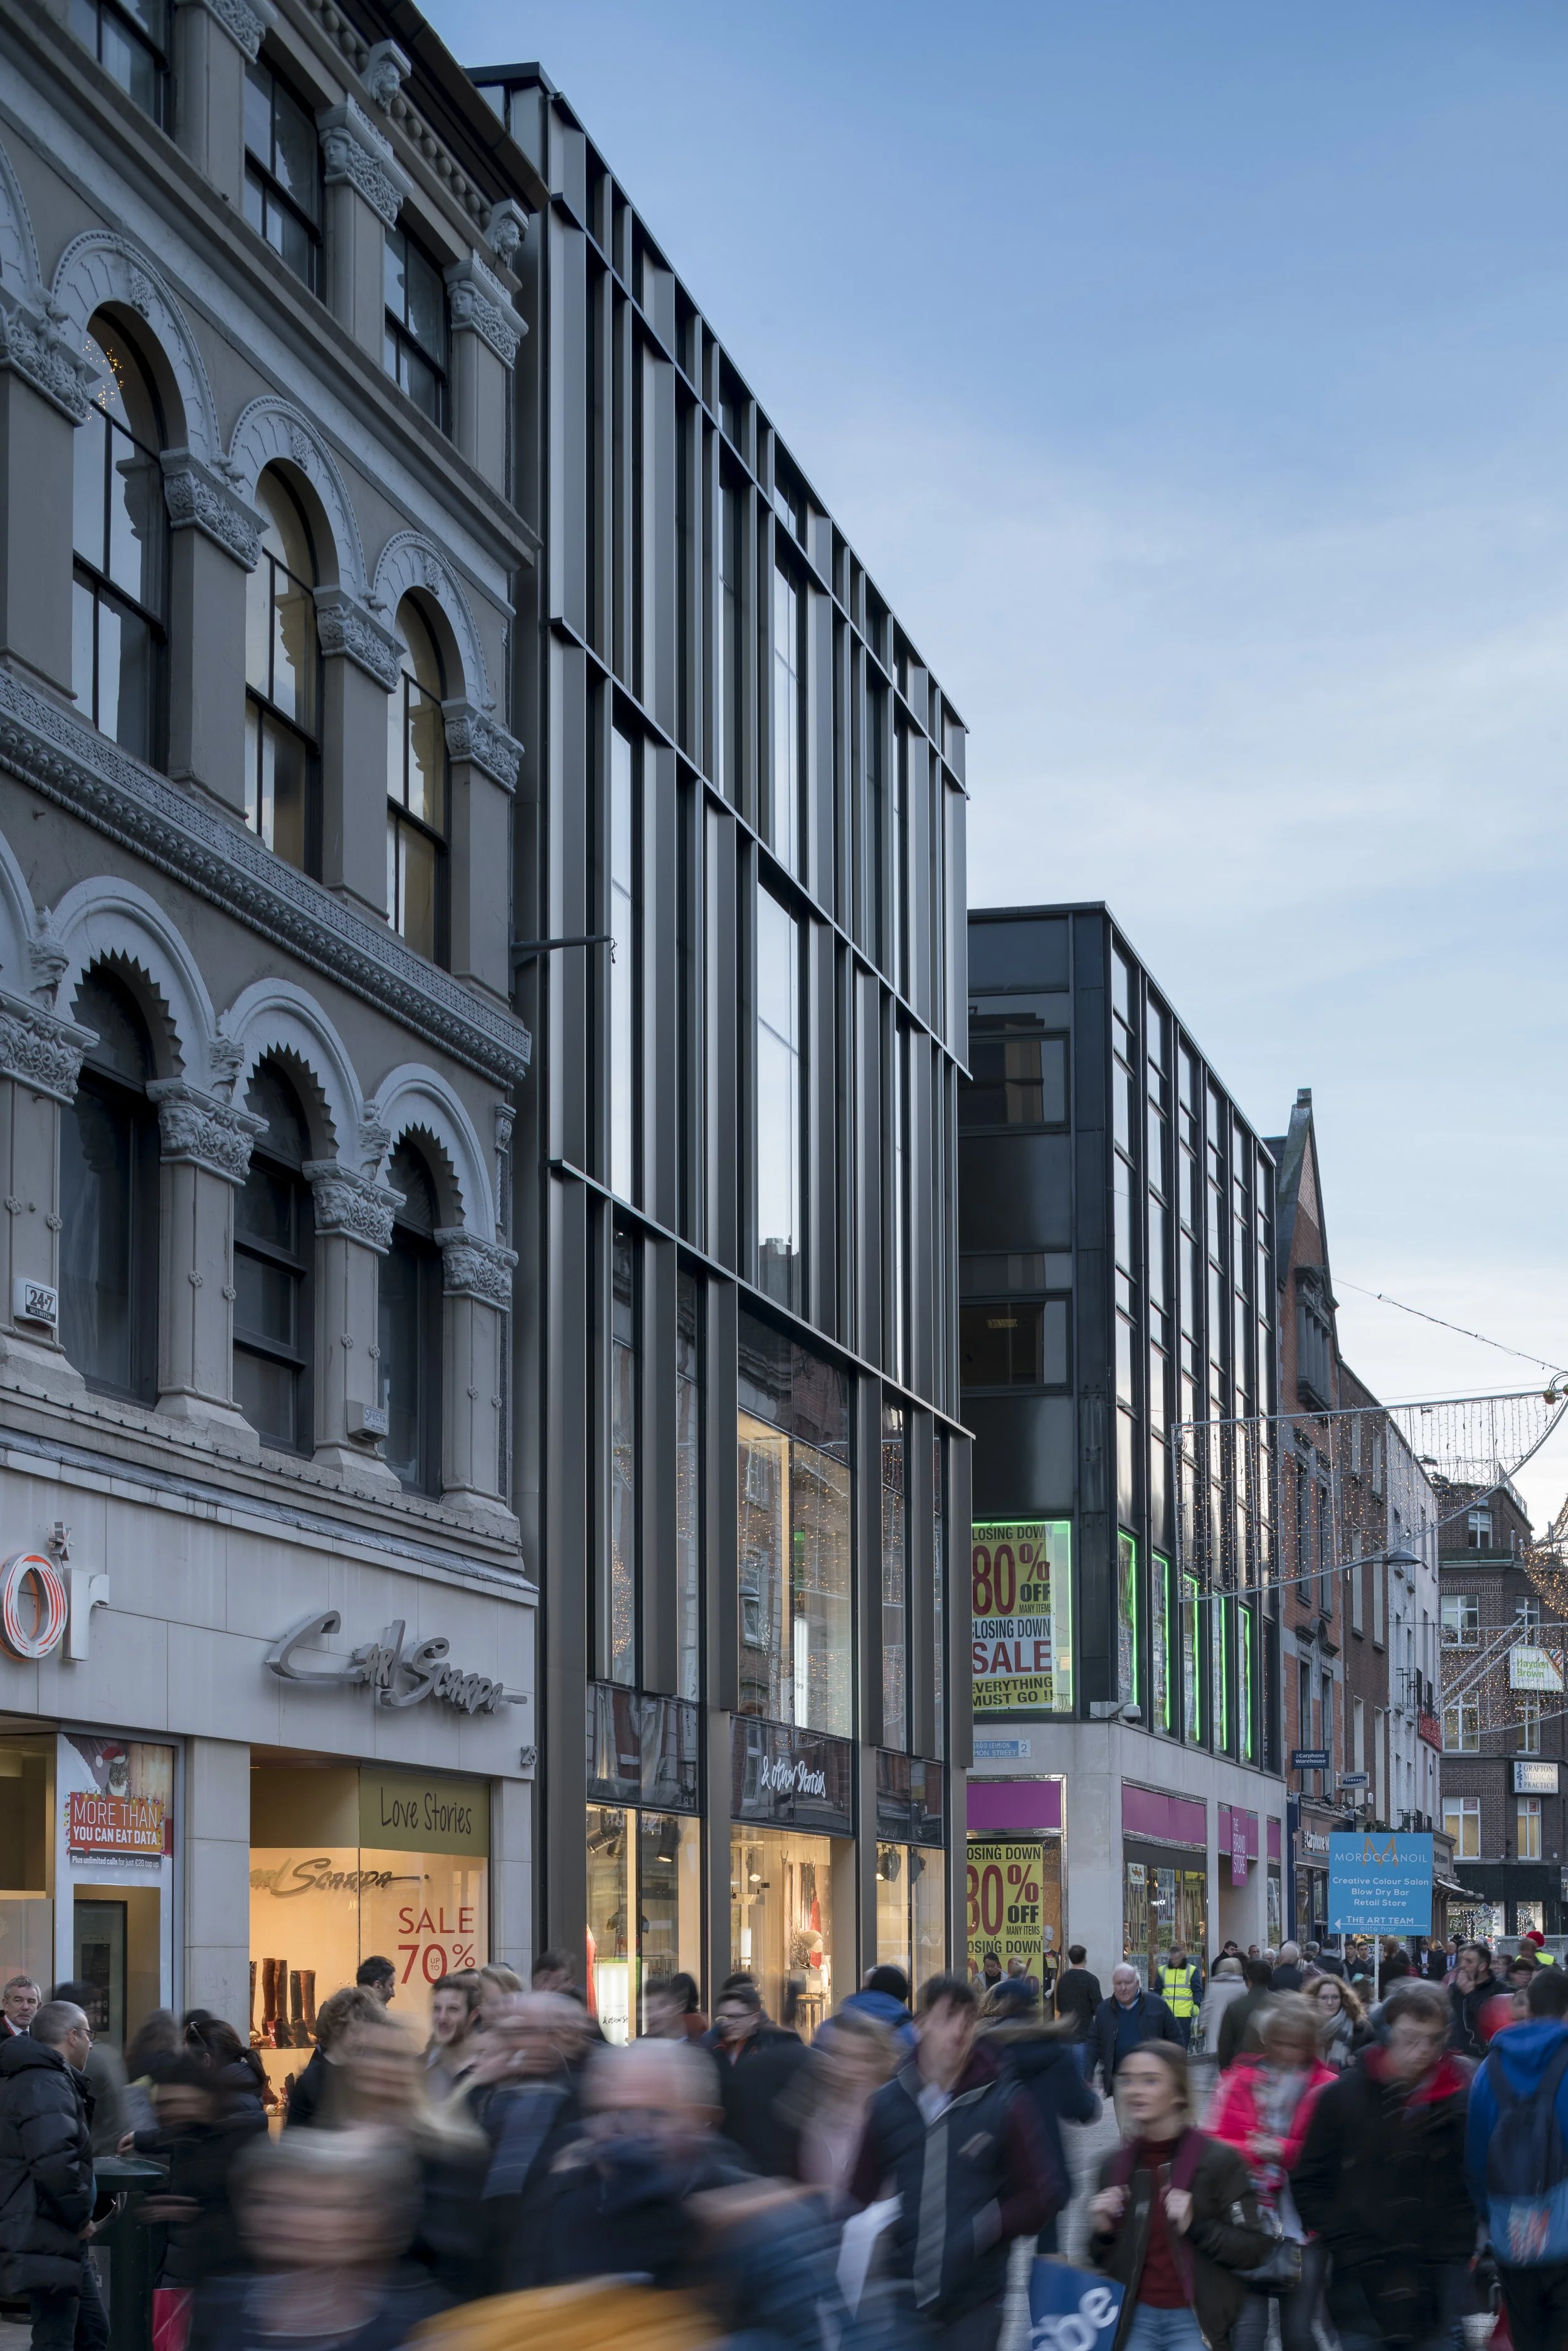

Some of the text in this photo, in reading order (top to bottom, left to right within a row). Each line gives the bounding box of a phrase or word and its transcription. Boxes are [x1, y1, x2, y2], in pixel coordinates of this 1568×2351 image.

[972, 1524, 1052, 1541] LOSING DOWN
[972, 1542, 1051, 1616] 80%
[1020, 1583, 1050, 1602] OFF
[1, 1552, 110, 1661] or
[1019, 1603, 1052, 1613] MANY ITEMS
[1018, 1618, 1050, 1638] DOWN
[973, 1640, 1052, 1674] SALE
[1517, 1658, 1549, 1670] Hayden
[1517, 1668, 1544, 1677] Brown
[973, 1693, 1012, 1707] MUST
[1017, 1690, 1038, 1703] GO
[1021, 1744, 1027, 1753] 2
[761, 1756, 826, 1798] & other Stories
[1523, 1765, 1553, 1773] GRAFTON
[1523, 1773, 1555, 1781] MEDICAL
[74, 1800, 157, 1829] MORE THAN
[381, 1786, 472, 1835] Love Stories
[73, 1825, 157, 1846] YOU CAN EAT DATA
[1233, 1833, 1246, 1854] BRAND
[967, 1847, 1041, 1860] OSING DOWN
[1335, 1852, 1427, 1863] MOROCCANOIL
[72, 1855, 83, 1864] Plus
[83, 1856, 106, 1865] unlimited
[107, 1857, 118, 1866] calls
[125, 1859, 134, 1868] just
[153, 1861, 159, 1870] up
[1234, 1854, 1246, 1874] STORE
[1333, 1877, 1370, 1885] Creative
[1375, 1888, 1391, 1897] Dry
[398, 1907, 474, 1934] SALE
[1007, 1905, 1039, 1924] OFF
[1347, 1916, 1364, 1924] THE
[1007, 1925, 1040, 1935] MANY ITEMS
[968, 1940, 1041, 1953] OSING DOWN
[398, 1943, 476, 1985] 70%
